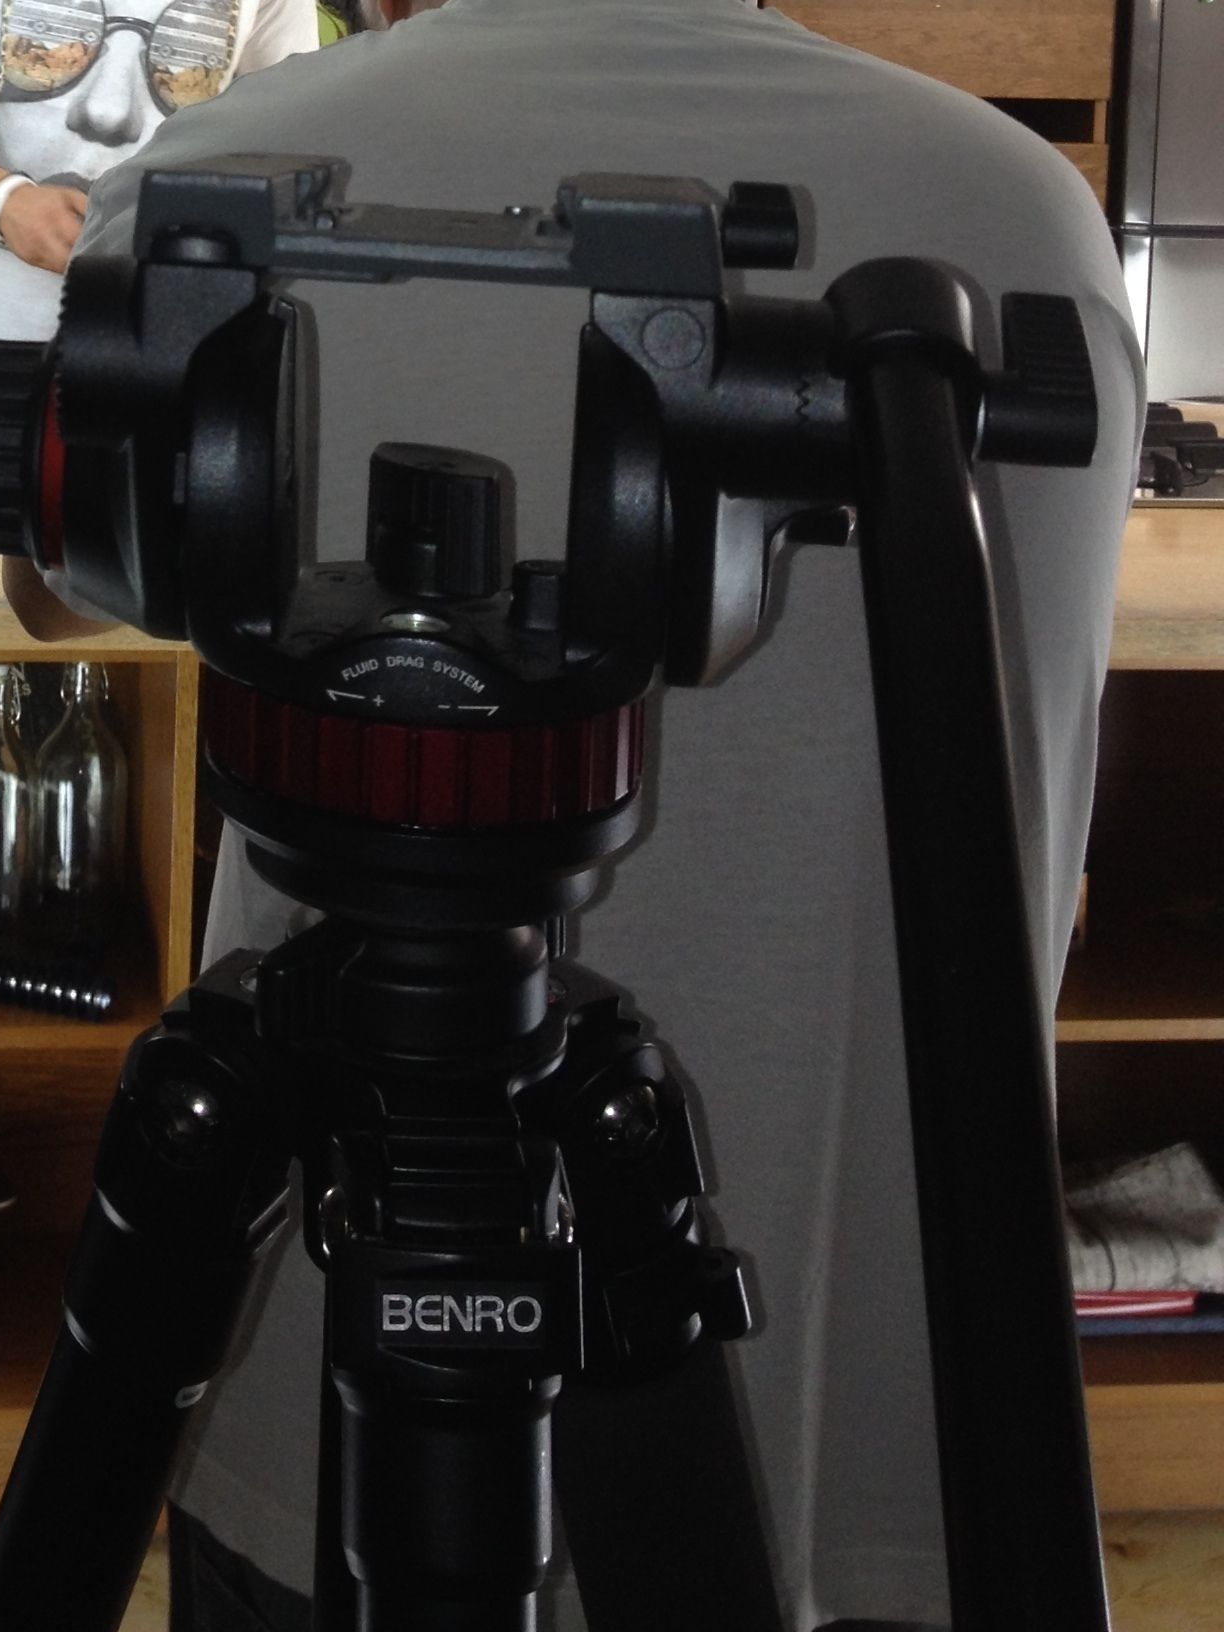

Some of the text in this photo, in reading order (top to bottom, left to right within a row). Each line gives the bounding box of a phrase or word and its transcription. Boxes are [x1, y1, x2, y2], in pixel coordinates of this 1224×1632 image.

[341, 655, 486, 694] FLUID DRAG SYSTEM
[382, 1294, 542, 1333] BENRO
